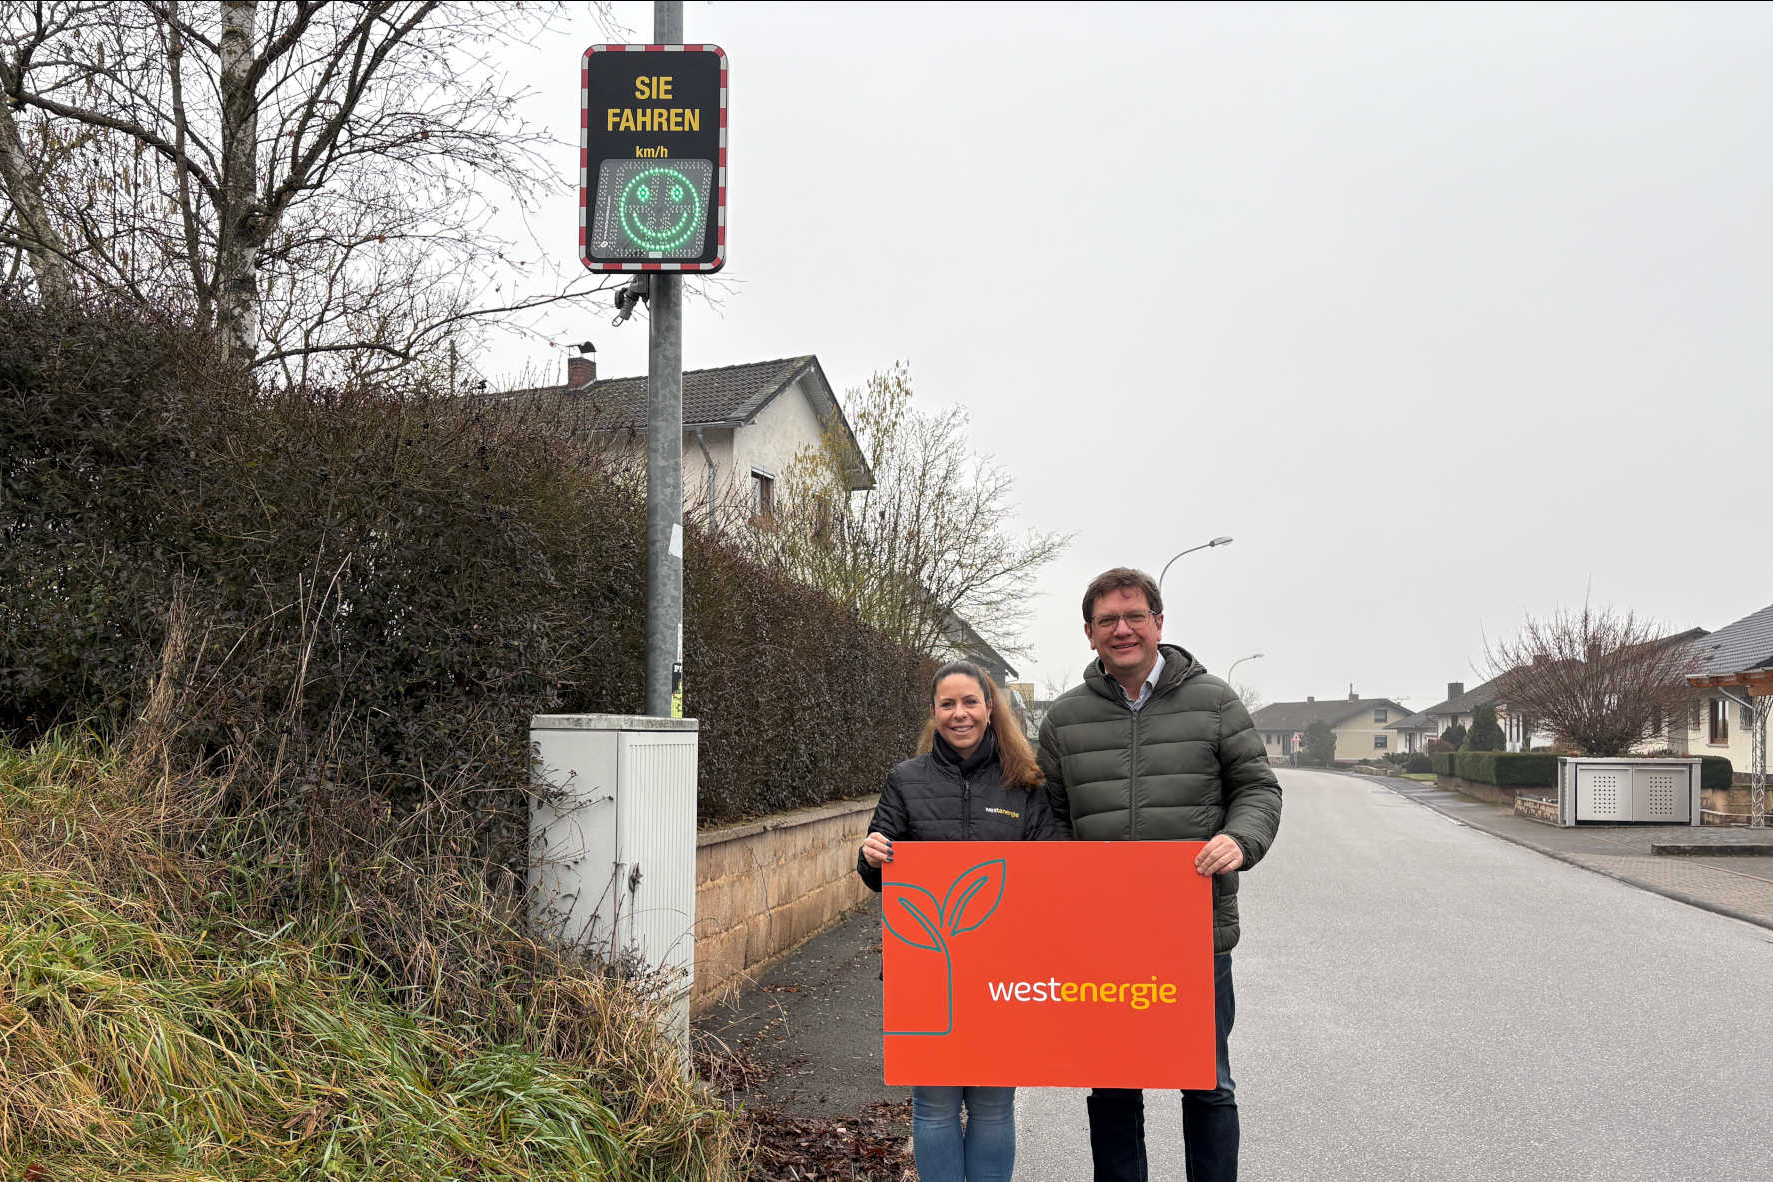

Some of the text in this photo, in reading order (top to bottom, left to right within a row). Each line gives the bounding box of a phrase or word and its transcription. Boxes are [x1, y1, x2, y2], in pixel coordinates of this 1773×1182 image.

[635, 75, 673, 100] SIE
[607, 108, 700, 132] FAHREN
[635, 145, 669, 158] km/h
[988, 975, 1177, 1010] westenergie
